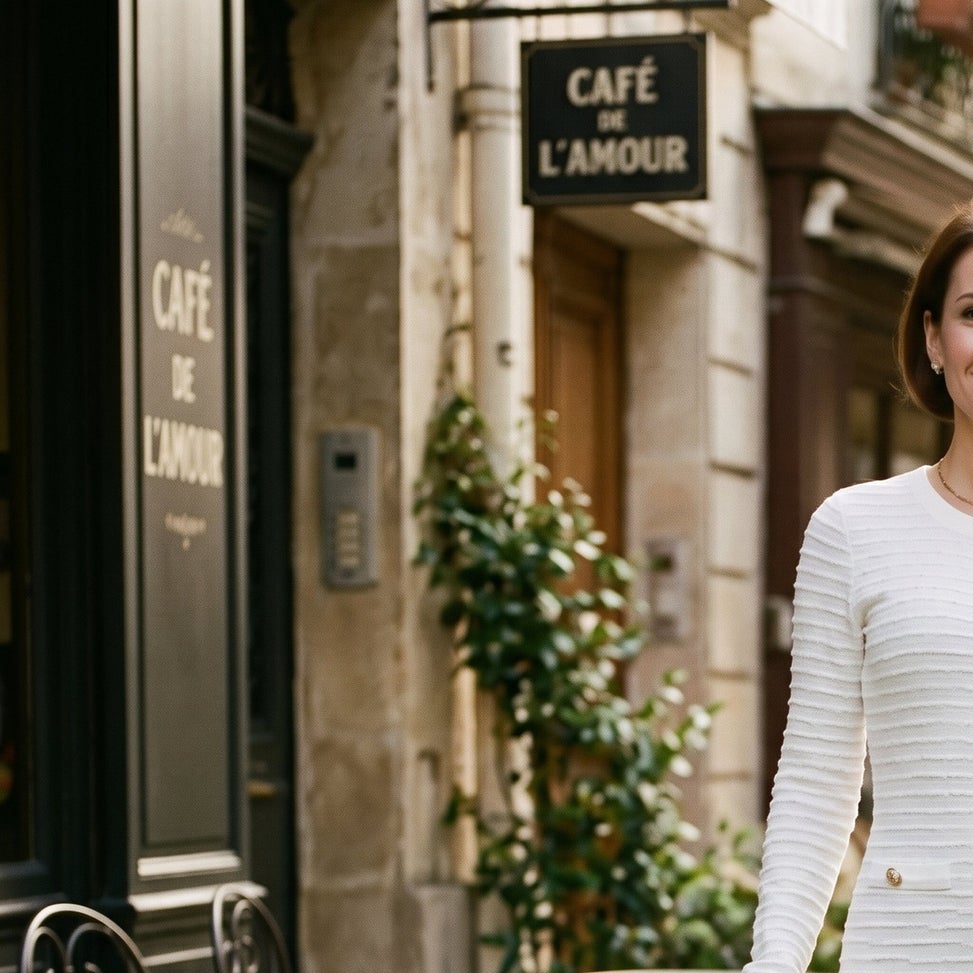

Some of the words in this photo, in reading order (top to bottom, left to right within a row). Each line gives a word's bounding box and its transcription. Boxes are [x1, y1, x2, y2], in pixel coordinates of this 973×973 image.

[566, 55, 659, 106] CAFÉ
[597, 109, 628, 132] DE
[538, 135, 688, 177] L'AMOUR
[152, 259, 214, 342] CAFÉ
[172, 354, 196, 403] DE
[144, 414, 224, 488] L'AMOUR
